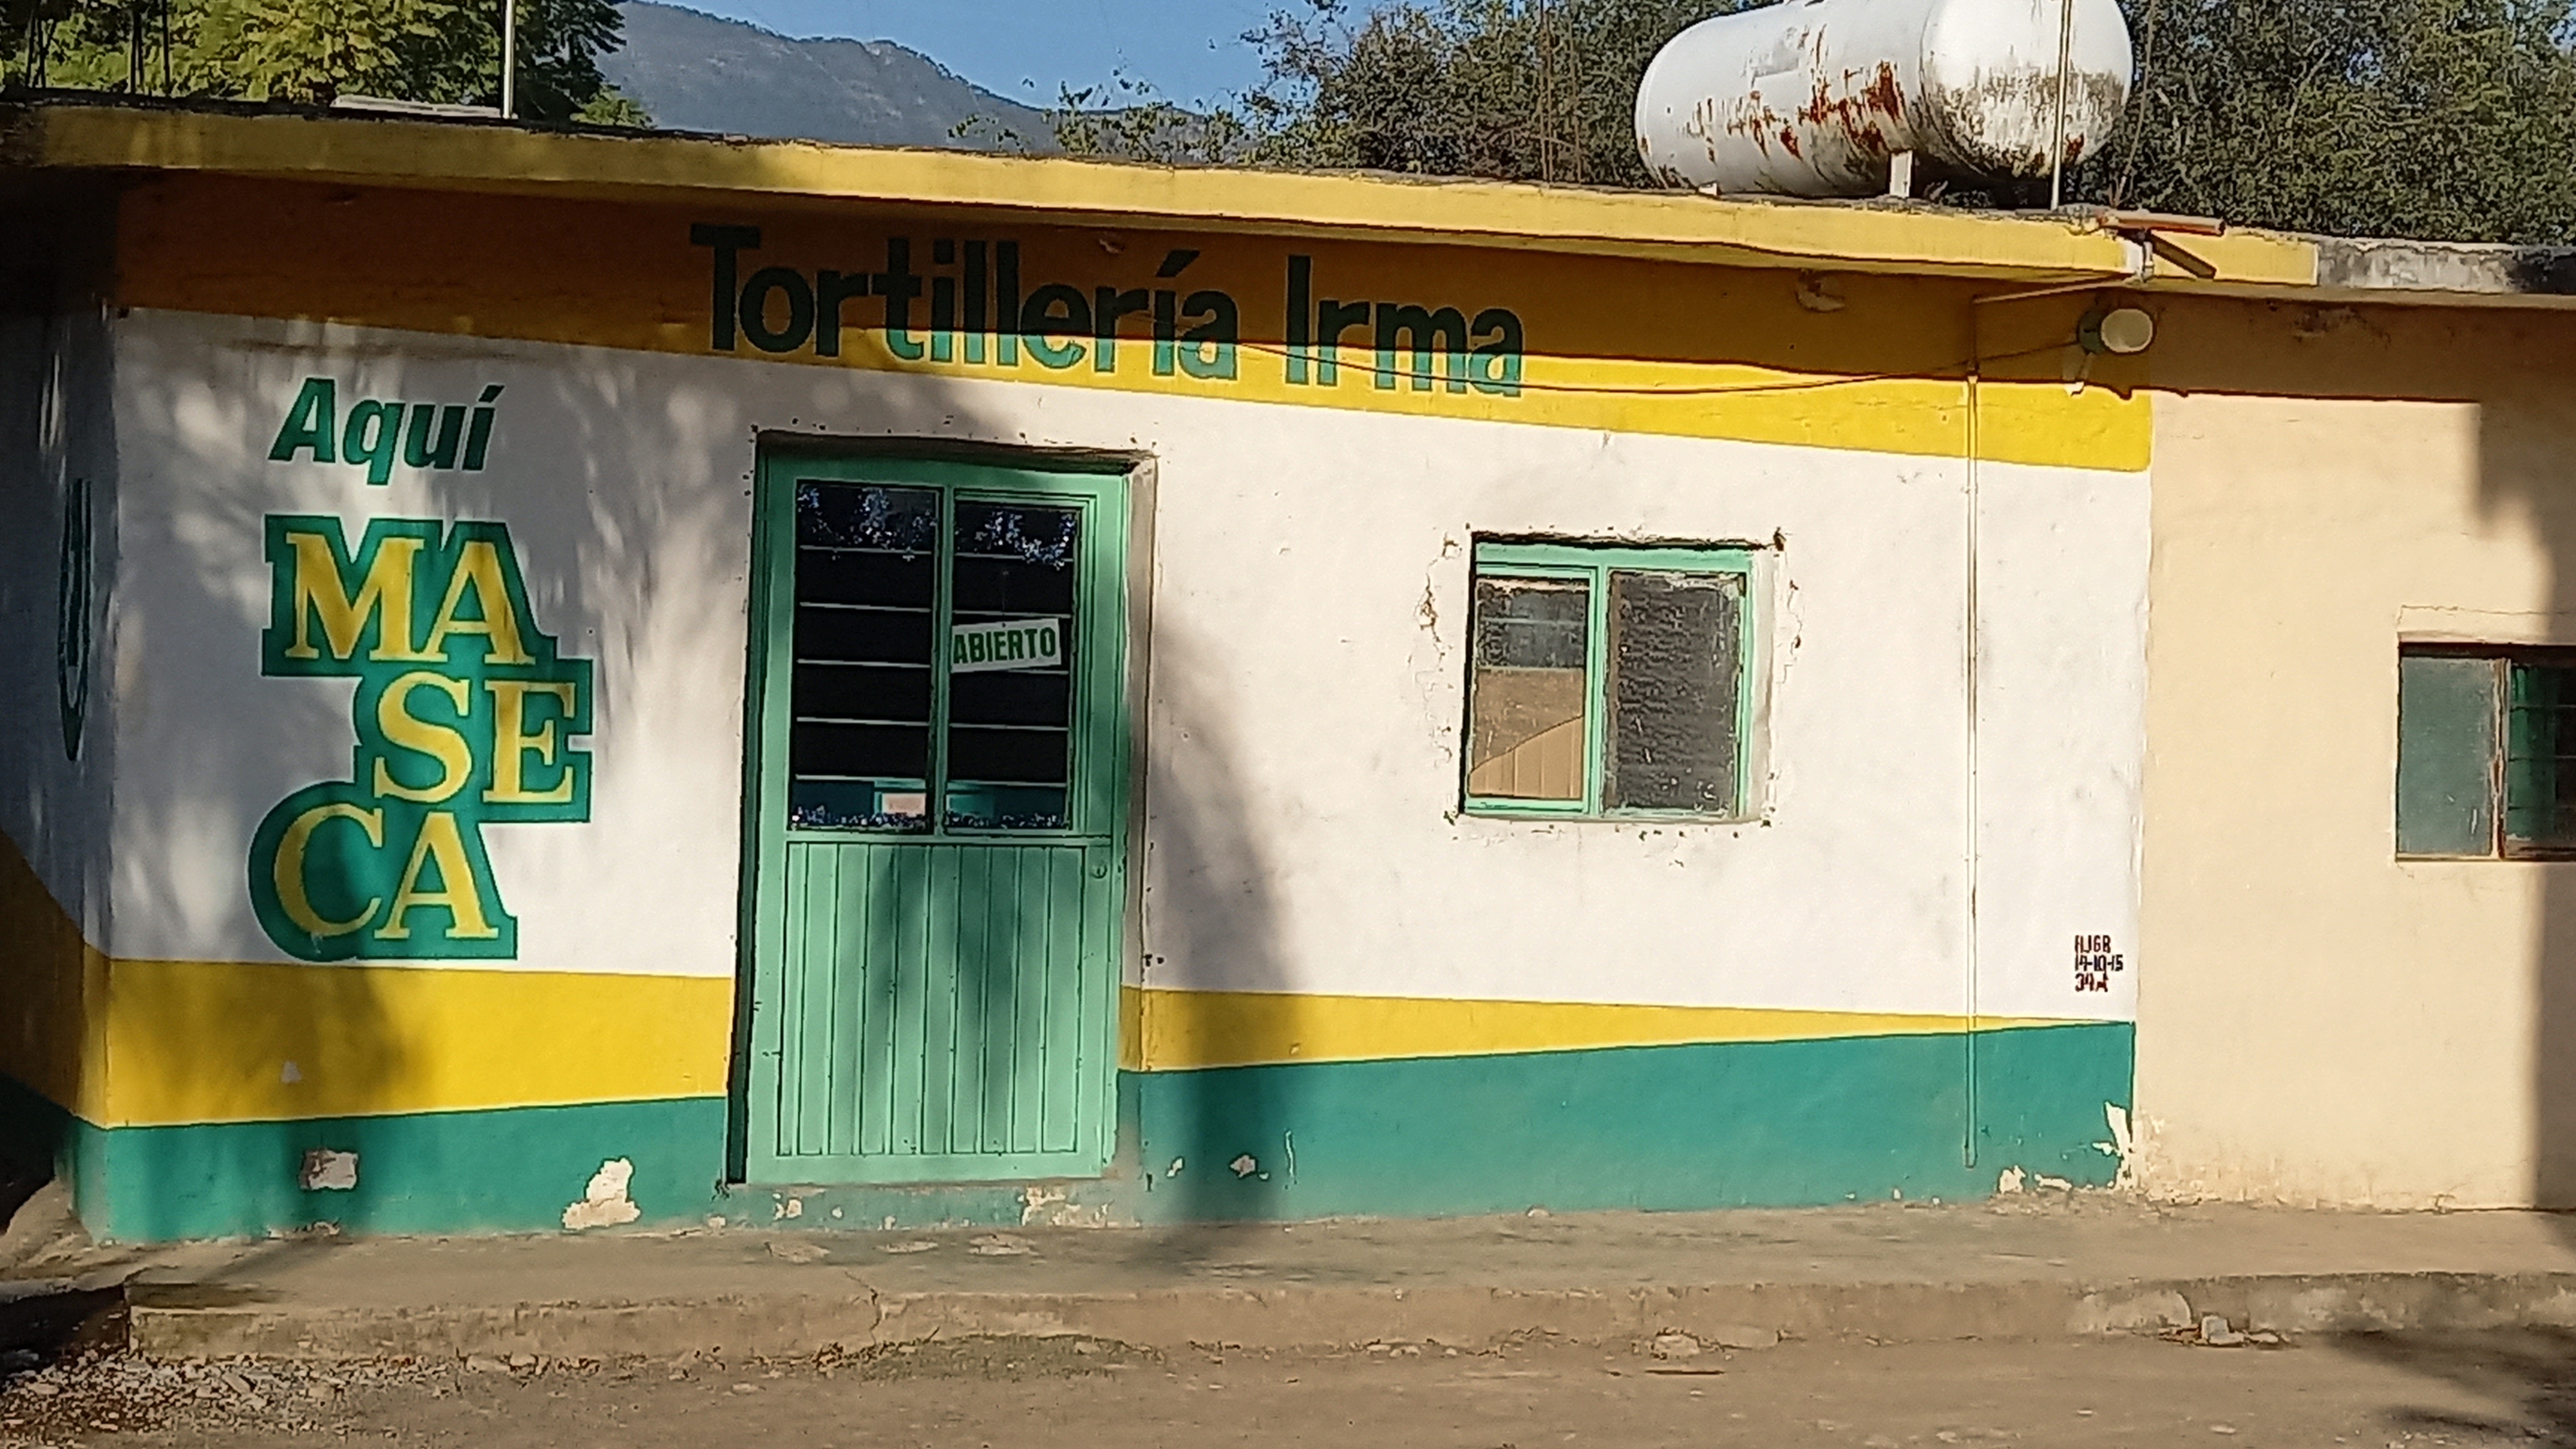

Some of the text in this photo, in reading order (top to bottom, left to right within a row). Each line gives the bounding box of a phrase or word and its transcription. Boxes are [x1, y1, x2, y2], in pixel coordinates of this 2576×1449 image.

[690, 222, 1524, 397] Tortillería Irma
[268, 377, 506, 486] Aquí
[952, 627, 1056, 665] ABIERTO
